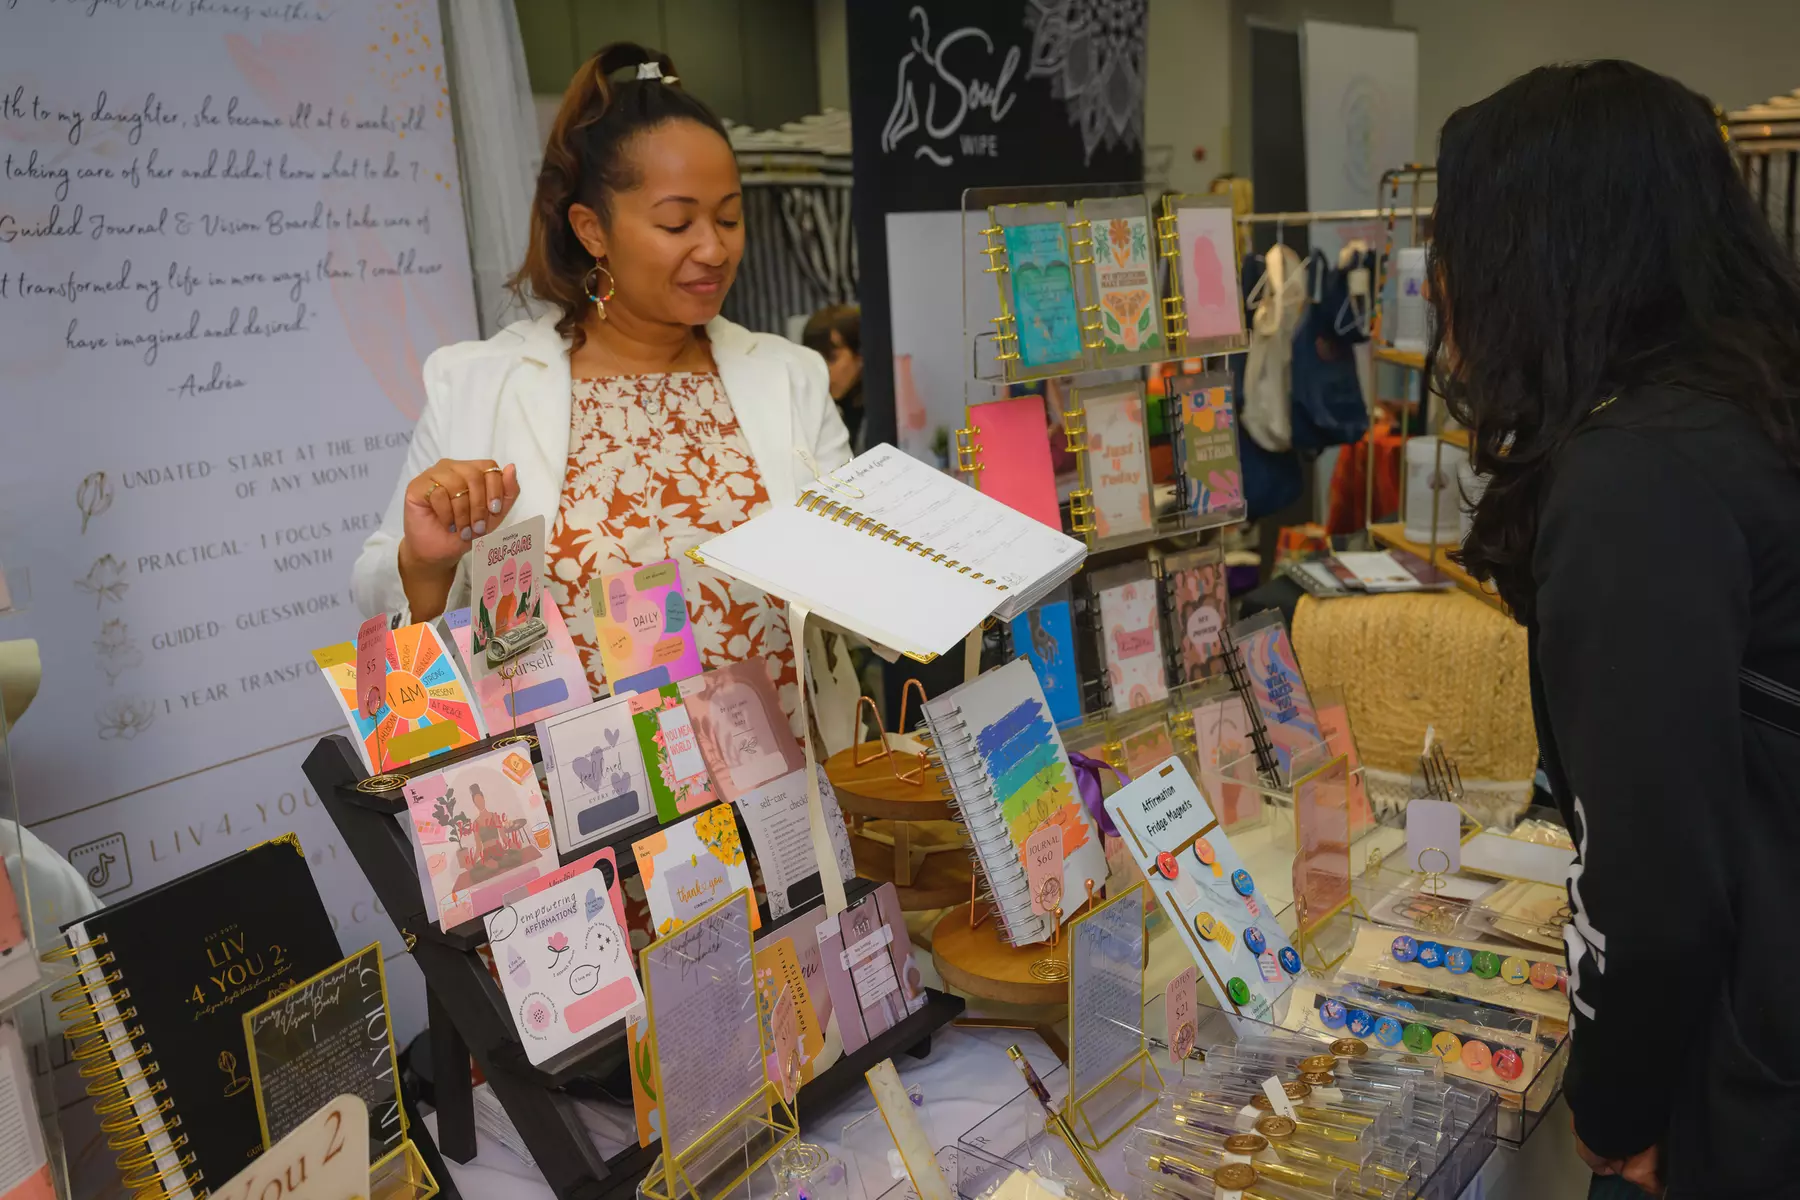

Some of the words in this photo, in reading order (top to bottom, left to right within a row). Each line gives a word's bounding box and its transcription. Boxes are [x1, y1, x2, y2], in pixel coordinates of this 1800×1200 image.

[926, 26, 1021, 139] Soul
[32, 95, 52, 121] to
[58, 109, 84, 146] my
[194, 94, 221, 128] she
[959, 134, 998, 156] WIFE
[5, 149, 70, 202] taking
[77, 166, 115, 179] care
[122, 157, 140, 189] of
[147, 148, 174, 178] her
[181, 148, 218, 179] and
[279, 152, 315, 180] know
[0, 203, 84, 244] Guided
[89, 207, 169, 240] Journal
[200, 214, 261, 237] Vision
[266, 201, 323, 236] Board
[18, 258, 131, 304] transformed
[136, 278, 161, 313] my
[168, 261, 201, 297] life
[208, 272, 227, 287] in
[231, 272, 266, 287] more
[65, 318, 108, 350] have
[115, 308, 200, 366] imagined
[203, 306, 240, 338] and
[227, 448, 287, 474] START
[295, 443, 316, 462] AT
[326, 437, 356, 457] THE
[235, 480, 259, 499] OF
[269, 474, 302, 494] ANY
[312, 461, 370, 487] MONTH
[1100, 471, 1140, 488] Today
[275, 520, 332, 548] FOCUS
[340, 511, 383, 533] AREA
[273, 547, 333, 575] MONTH
[487, 534, 532, 566] SELF-CARE
[235, 590, 341, 631] GUESSWORK
[632, 611, 659, 628] DAILY
[422, 667, 445, 685] STRONG
[497, 652, 555, 687] yourself
[178, 683, 231, 711] YEAR
[388, 692, 397, 707] I
[400, 683, 425, 705] AM
[428, 687, 455, 698] PRESENT
[431, 701, 441, 710] AT
[442, 704, 464, 719] PEACE
[665, 728, 678, 743] YOU
[669, 739, 692, 756] WORLD
[579, 761, 598, 790] feel
[600, 751, 622, 778] loved
[588, 793, 610, 804] EVERY
[760, 791, 788, 810] self-care
[1141, 785, 1176, 814] Affirmation
[1146, 816, 1169, 837] Fridge
[1165, 800, 1193, 823] Magnets
[1028, 835, 1060, 857] JOURNAL
[1036, 850, 1055, 868] $60
[676, 878, 703, 904] thank
[708, 875, 725, 896] you
[520, 892, 577, 925] empowering
[525, 905, 578, 936] AFFIRMATIONS
[206, 932, 244, 968] LIV
[210, 953, 264, 993] YOU
[1170, 971, 1190, 992] LOTUS
[1175, 990, 1187, 1002] PEN
[1176, 1001, 1189, 1019] $21
[321, 1110, 347, 1167] 2
